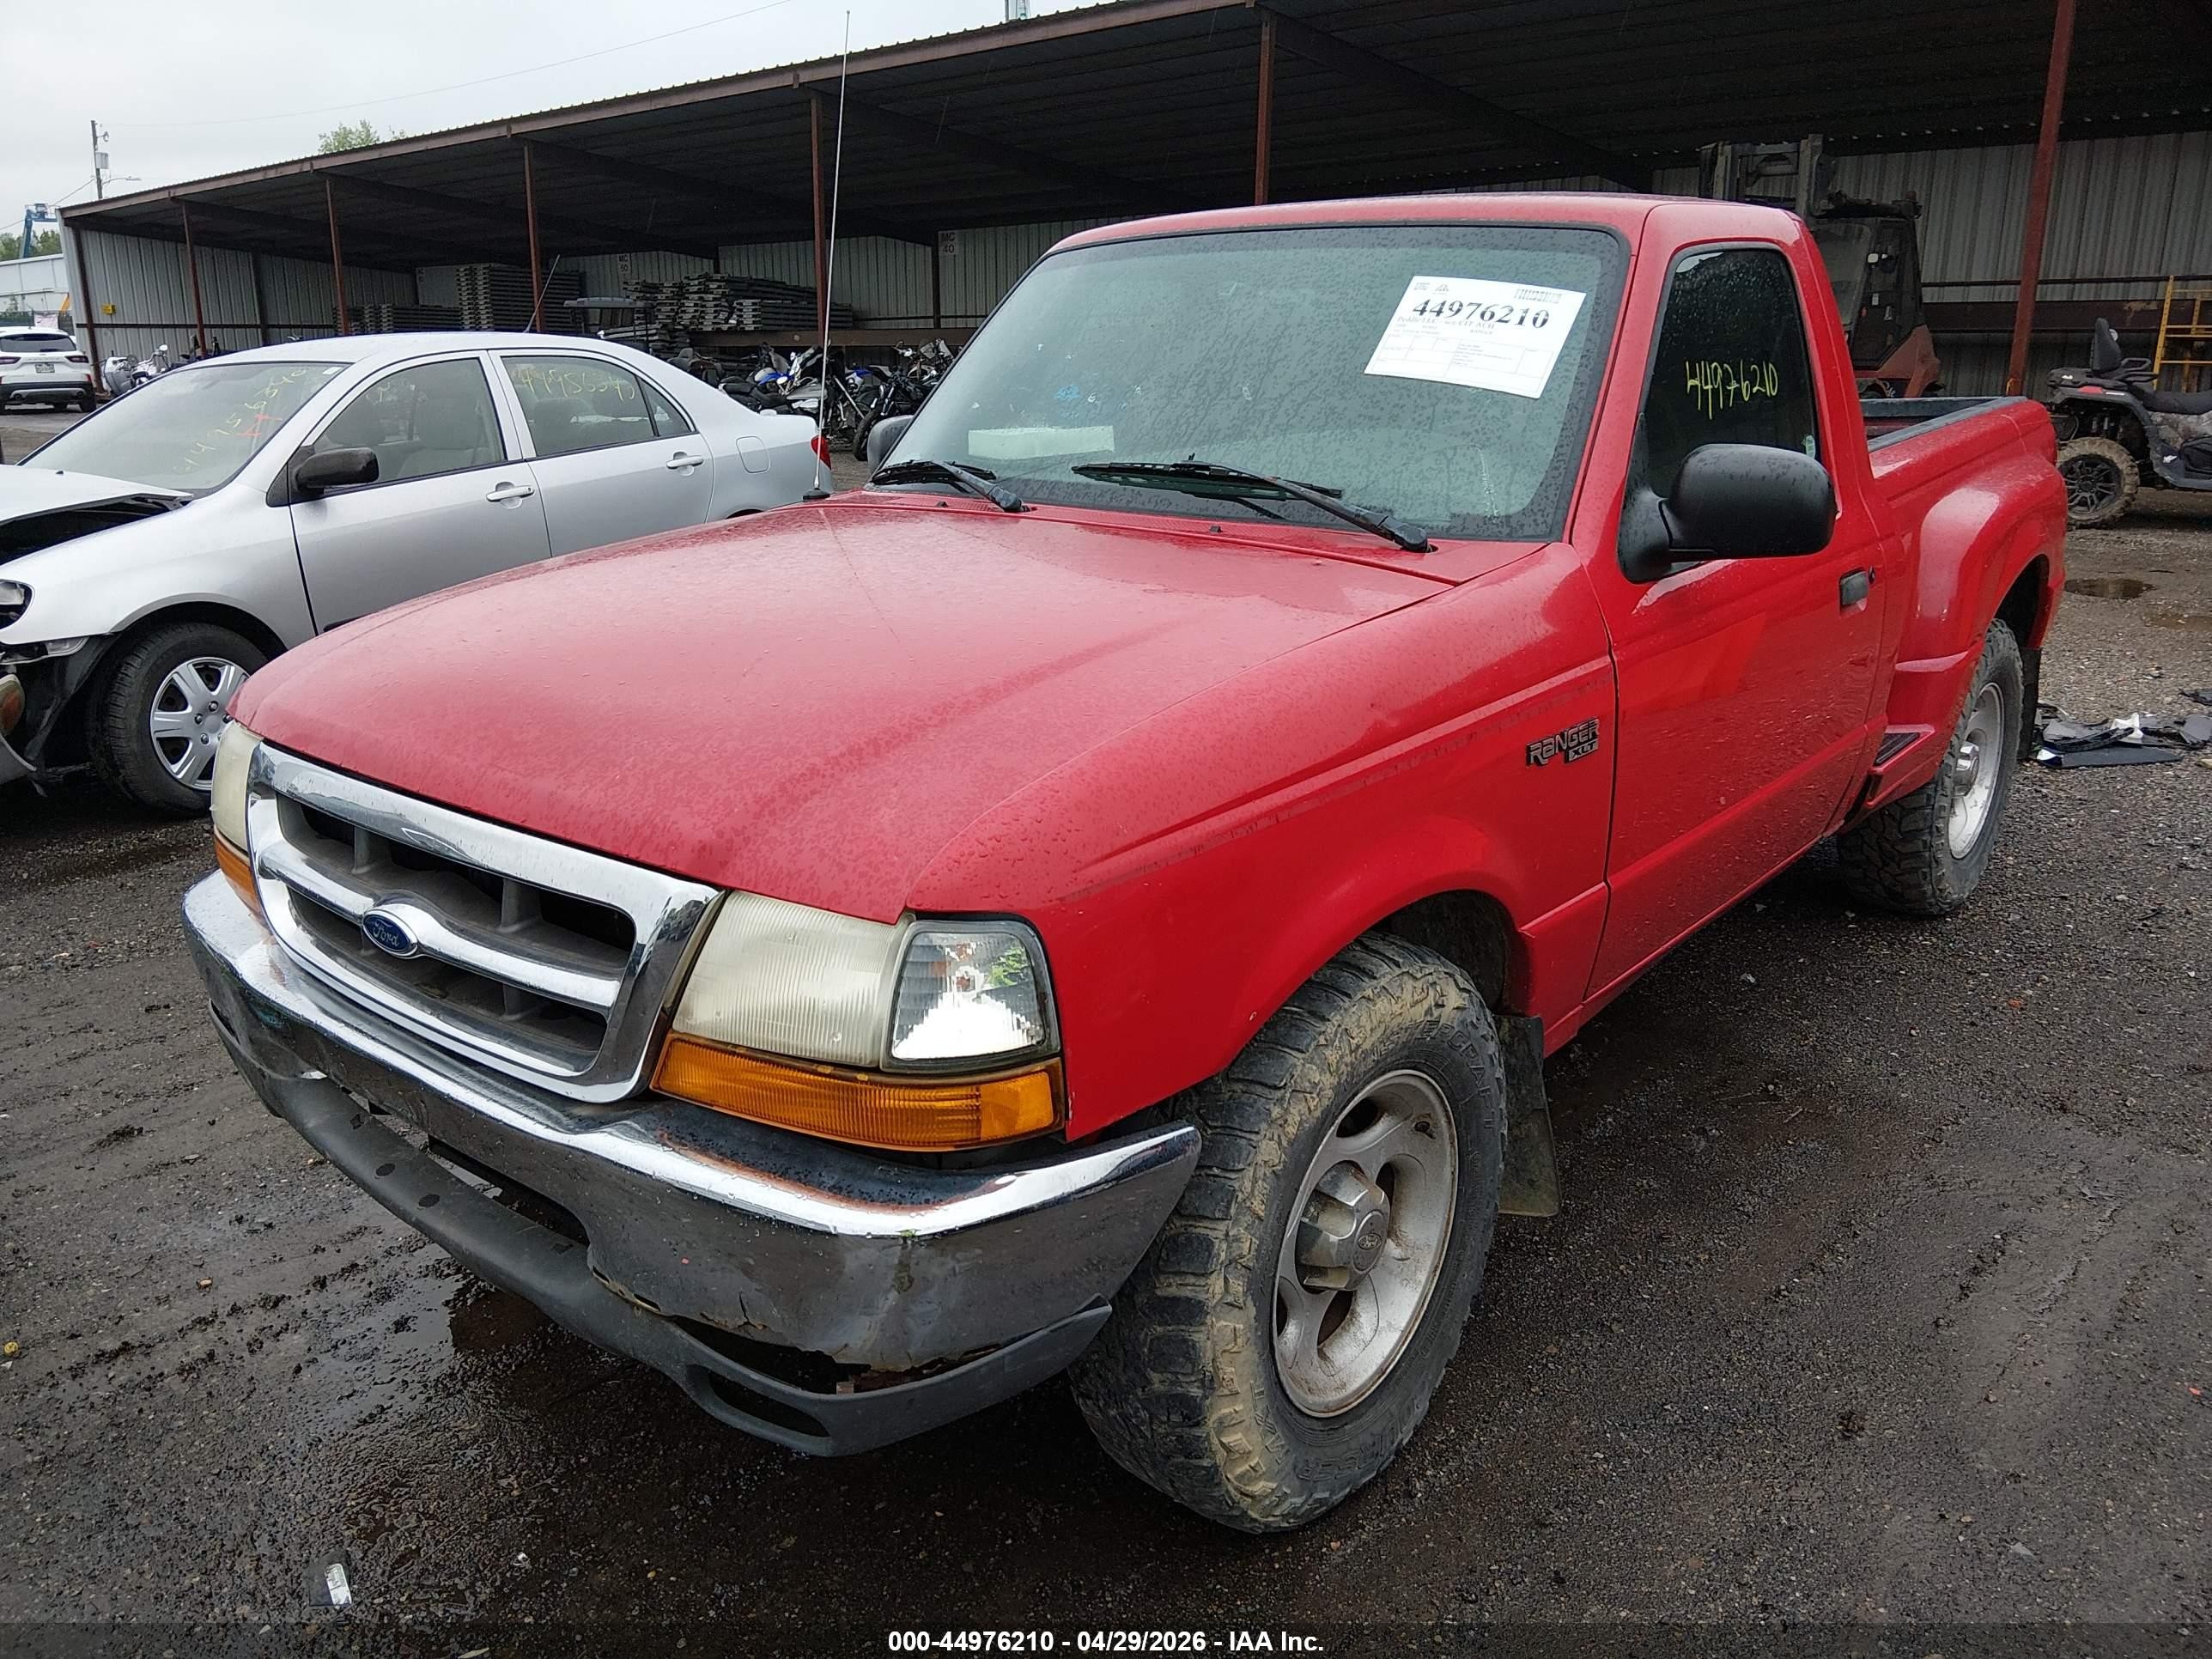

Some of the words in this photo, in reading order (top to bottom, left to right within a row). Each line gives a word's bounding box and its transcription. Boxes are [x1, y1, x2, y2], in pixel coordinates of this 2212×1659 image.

[942, 244, 955, 253] 40
[1412, 298, 1550, 329] 44976210
[1685, 358, 1779, 420] 44976210
[1527, 716, 1600, 765] RANGER
[1570, 740, 1598, 761] XLT
[372, 919, 400, 947] Ford
